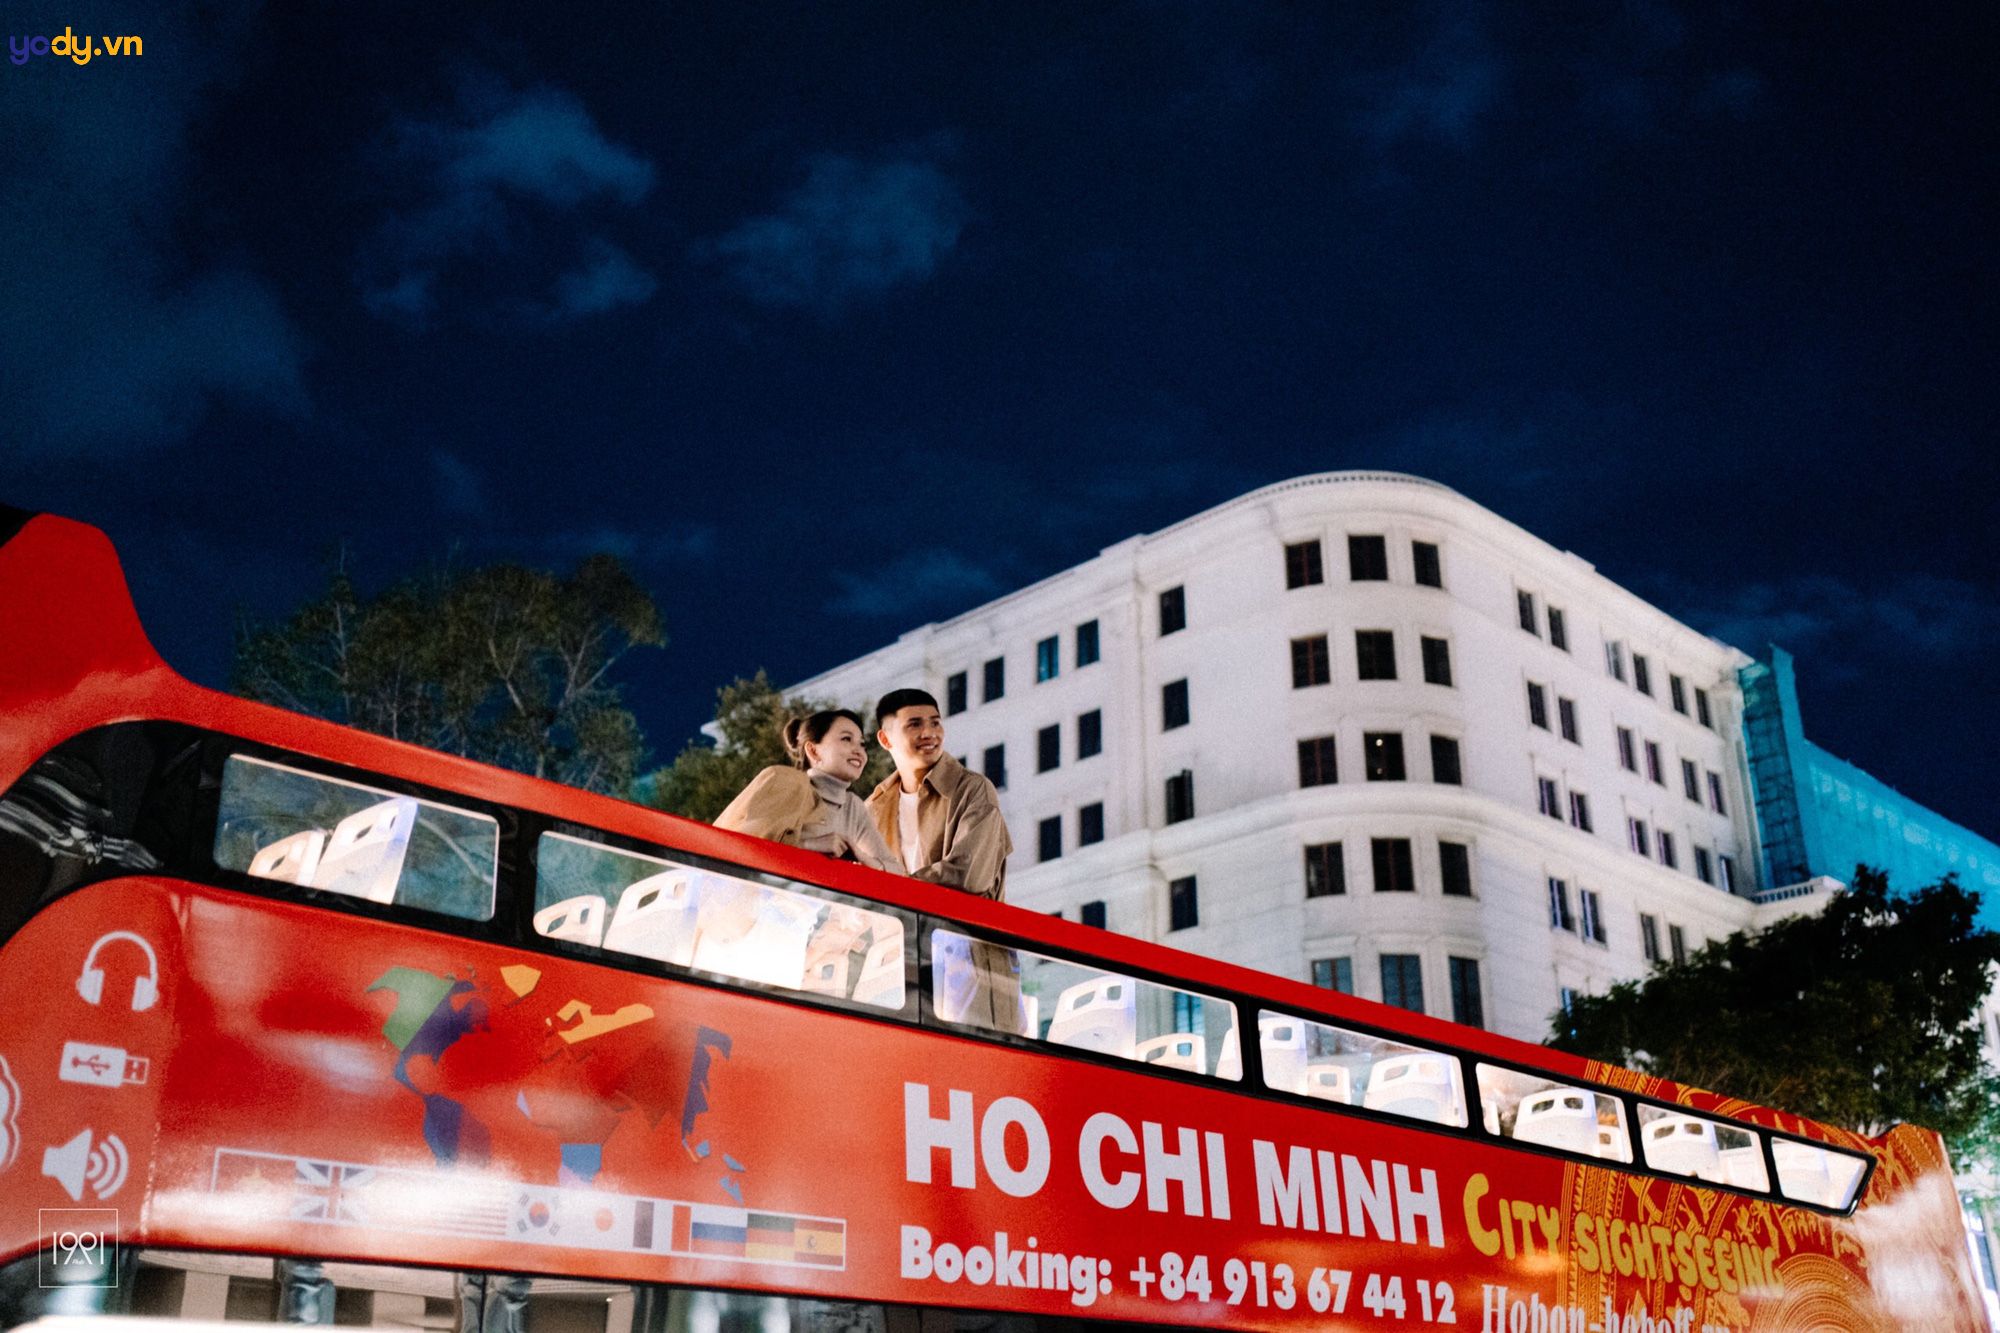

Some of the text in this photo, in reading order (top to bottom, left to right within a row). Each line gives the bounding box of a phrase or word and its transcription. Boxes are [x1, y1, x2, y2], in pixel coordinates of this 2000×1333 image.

[903, 1082, 1051, 1197] HO
[1078, 1112, 1231, 1221] CHI
[1252, 1139, 1445, 1248] MINH
[901, 1225, 1457, 1324] Booking: +84 913 67 44 12
